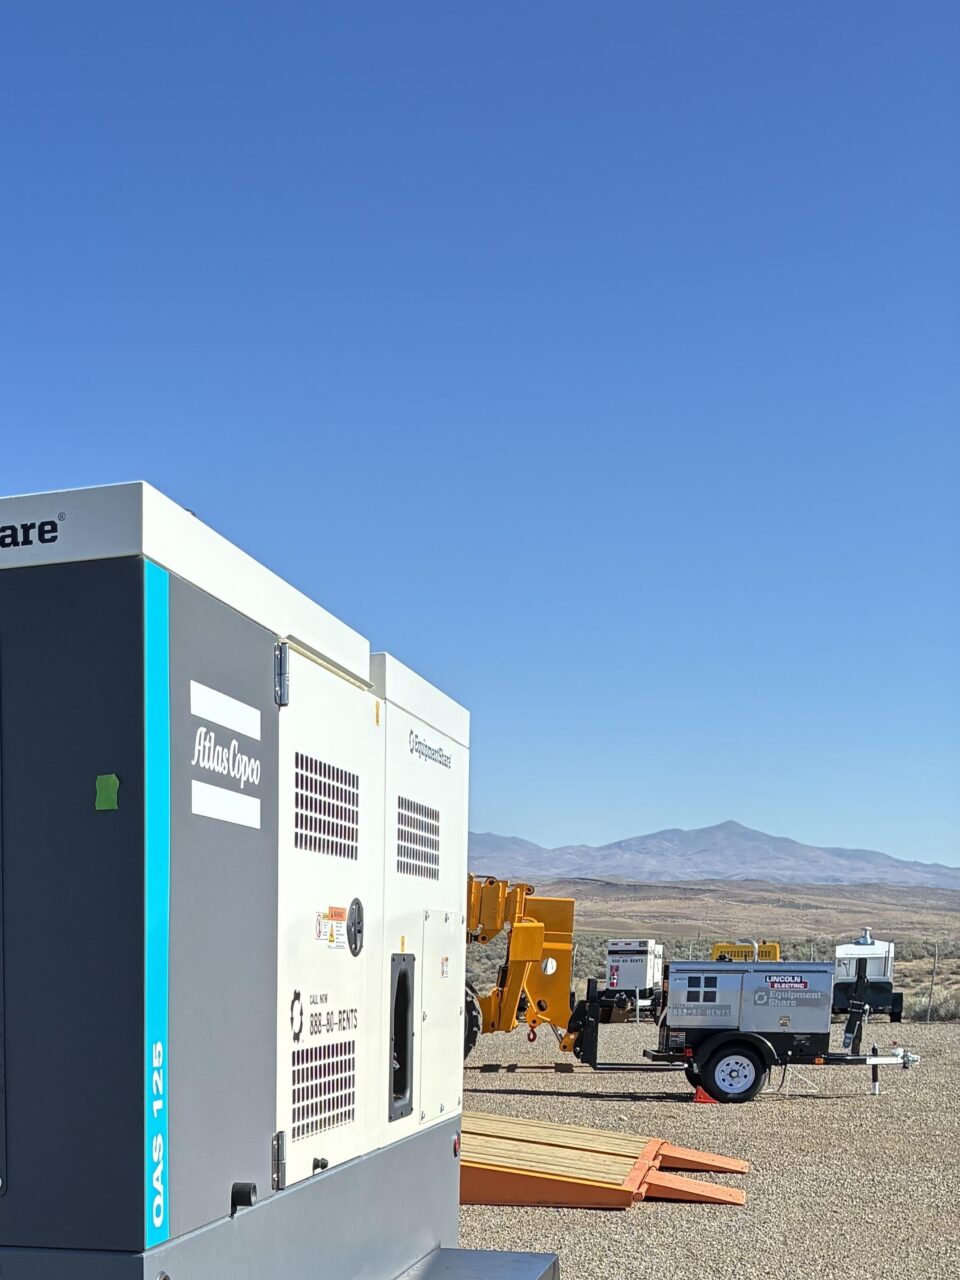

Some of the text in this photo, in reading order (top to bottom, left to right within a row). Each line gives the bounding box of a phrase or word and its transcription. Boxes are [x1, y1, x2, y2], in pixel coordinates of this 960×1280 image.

[191, 726, 261, 789] Atlas Copco
[414, 734, 452, 769] EquipmentShare
[309, 993, 328, 1005] CALL NOW
[770, 991, 823, 1000] Equipment
[309, 1008, 357, 1036] 888-80-RENTS
[152, 1041, 164, 1228] QAS 125
